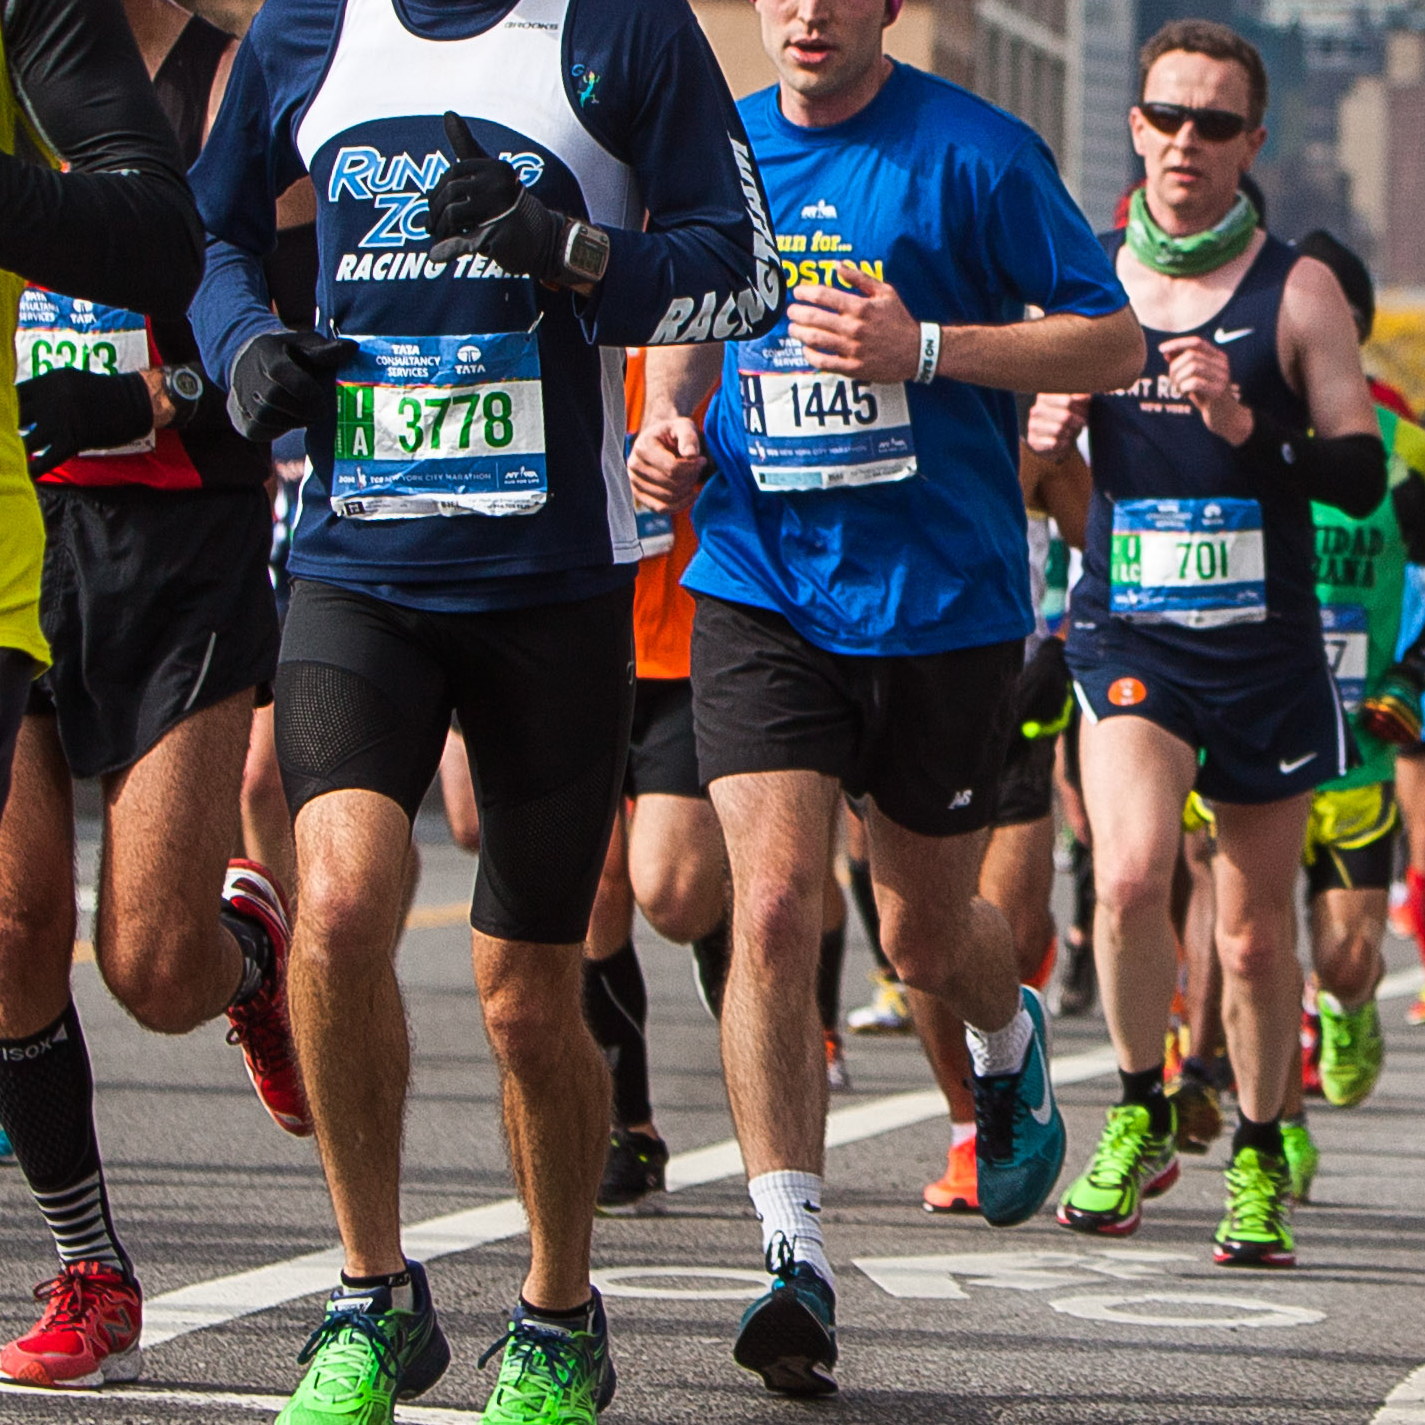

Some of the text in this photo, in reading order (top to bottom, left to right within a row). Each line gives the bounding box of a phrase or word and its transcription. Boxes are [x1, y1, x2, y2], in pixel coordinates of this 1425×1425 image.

[328, 146, 545, 202] RUNNG
[358, 192, 432, 248] ZO
[775, 235, 807, 253] un
[335, 252, 531, 282] RACING TEA
[781, 259, 884, 289] OSTN
[375, 355, 442, 367] CONSULTANCY
[391, 344, 421, 355] TATA
[386, 366, 429, 378] SERVICES
[454, 364, 487, 375] TATA
[791, 379, 878, 428] 1445
[397, 390, 514, 454] 3778
[749, 406, 763, 434] A
[352, 426, 369, 456] A
[1175, 539, 1229, 580] 701
